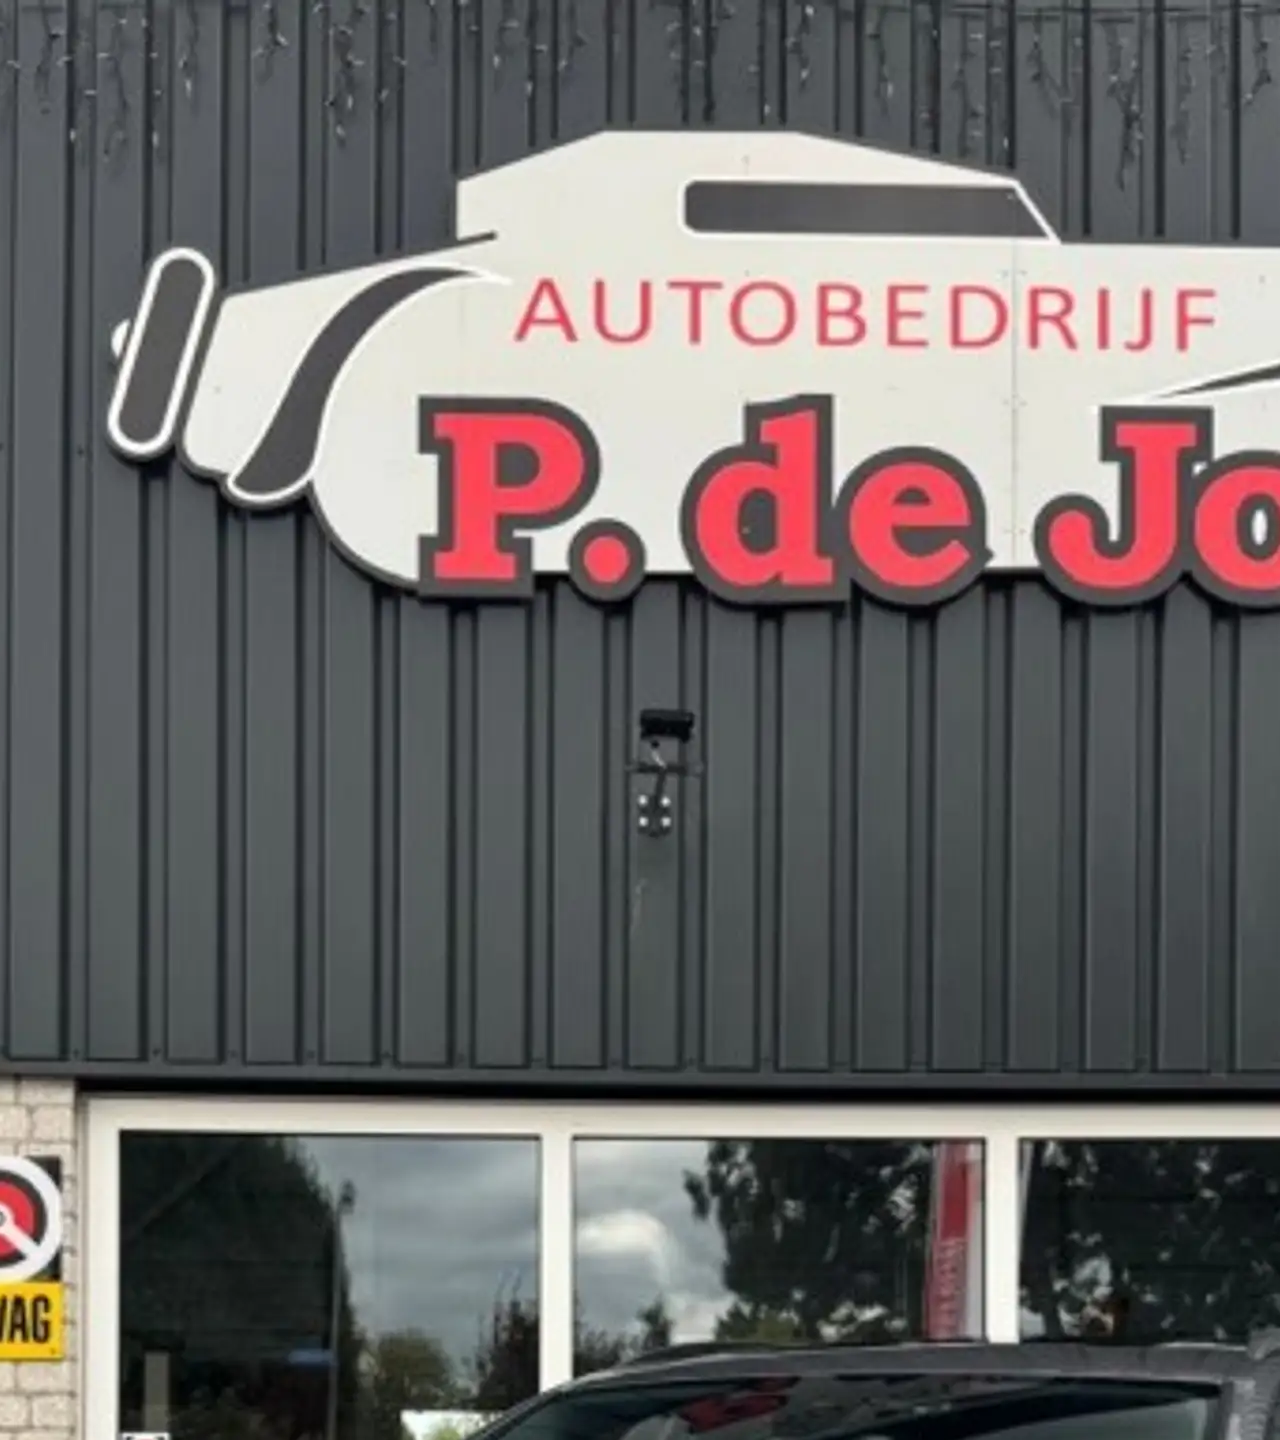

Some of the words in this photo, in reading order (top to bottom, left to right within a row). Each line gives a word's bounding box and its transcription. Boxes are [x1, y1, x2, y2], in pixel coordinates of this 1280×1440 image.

[513, 279, 1221, 349] AUTOBEDRIJF
[426, 405, 637, 591] P.
[689, 402, 978, 595] de
